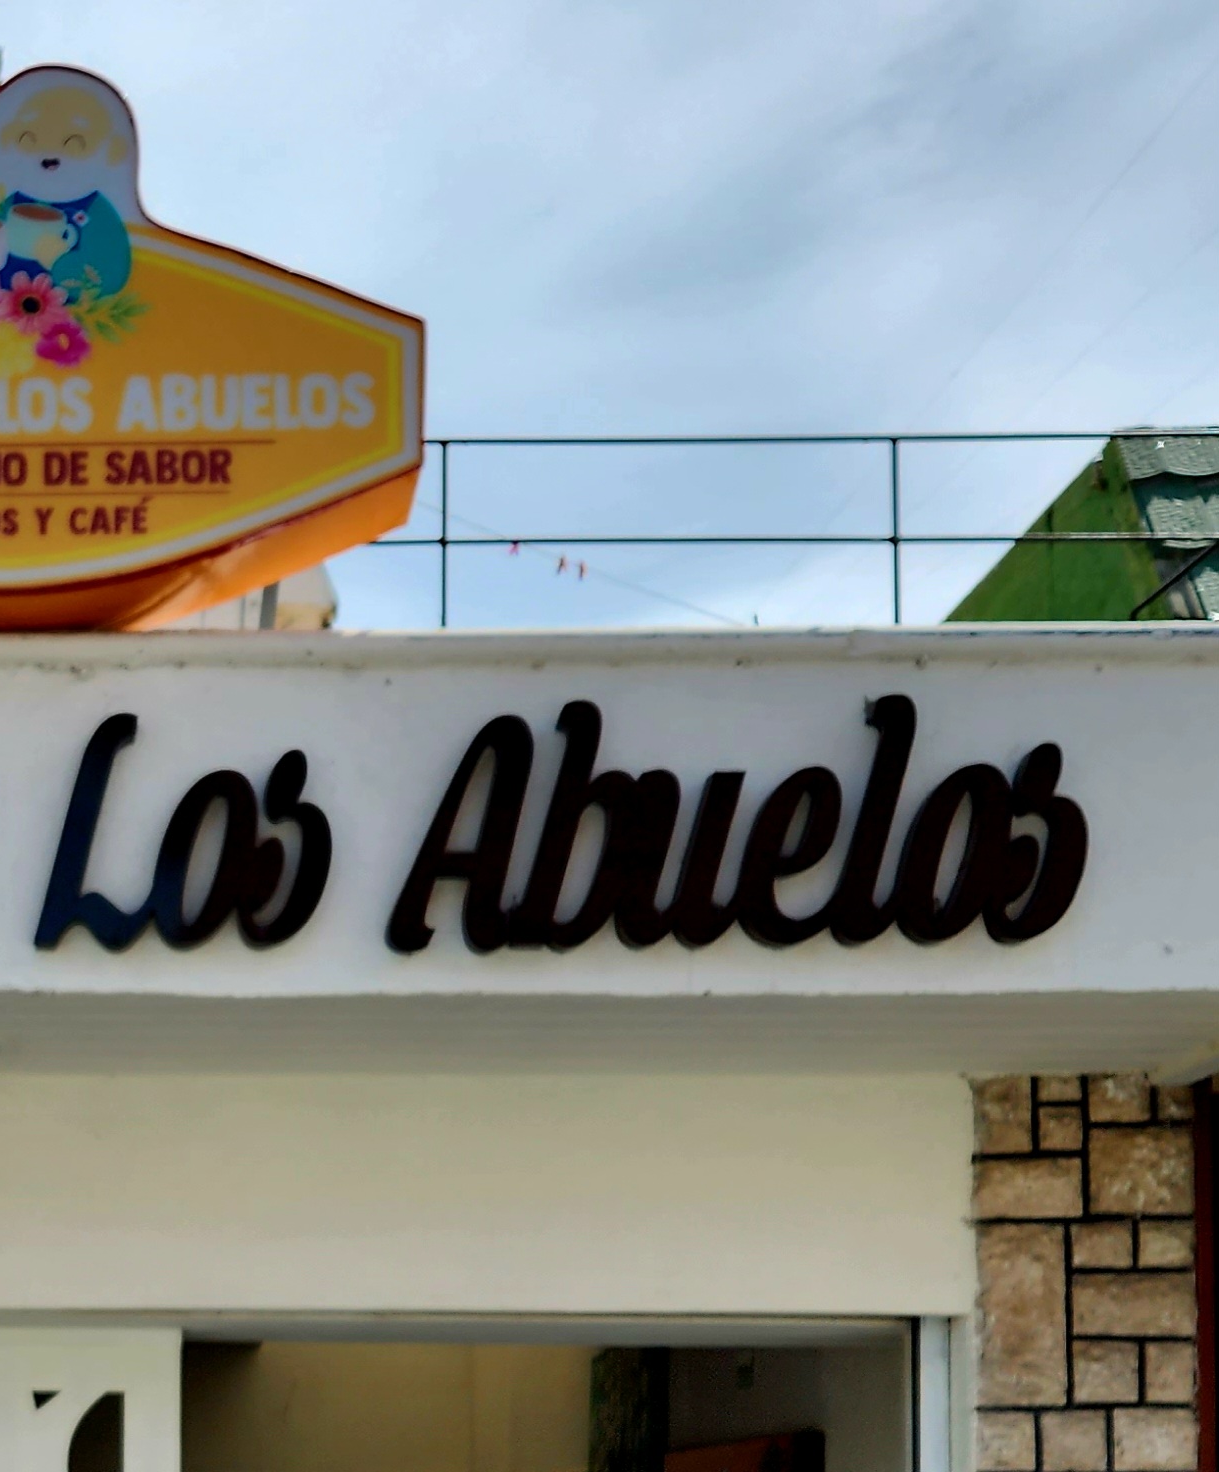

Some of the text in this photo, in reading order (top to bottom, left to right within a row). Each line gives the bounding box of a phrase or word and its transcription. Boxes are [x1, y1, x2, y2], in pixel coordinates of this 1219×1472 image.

[116, 372, 376, 432] ABUELOS
[43, 450, 89, 486] DE
[105, 448, 233, 485] SABOR
[35, 506, 55, 536] Y
[68, 494, 153, 536] CAFÉ
[34, 712, 333, 953] Los
[385, 693, 1089, 956] Abuelos
